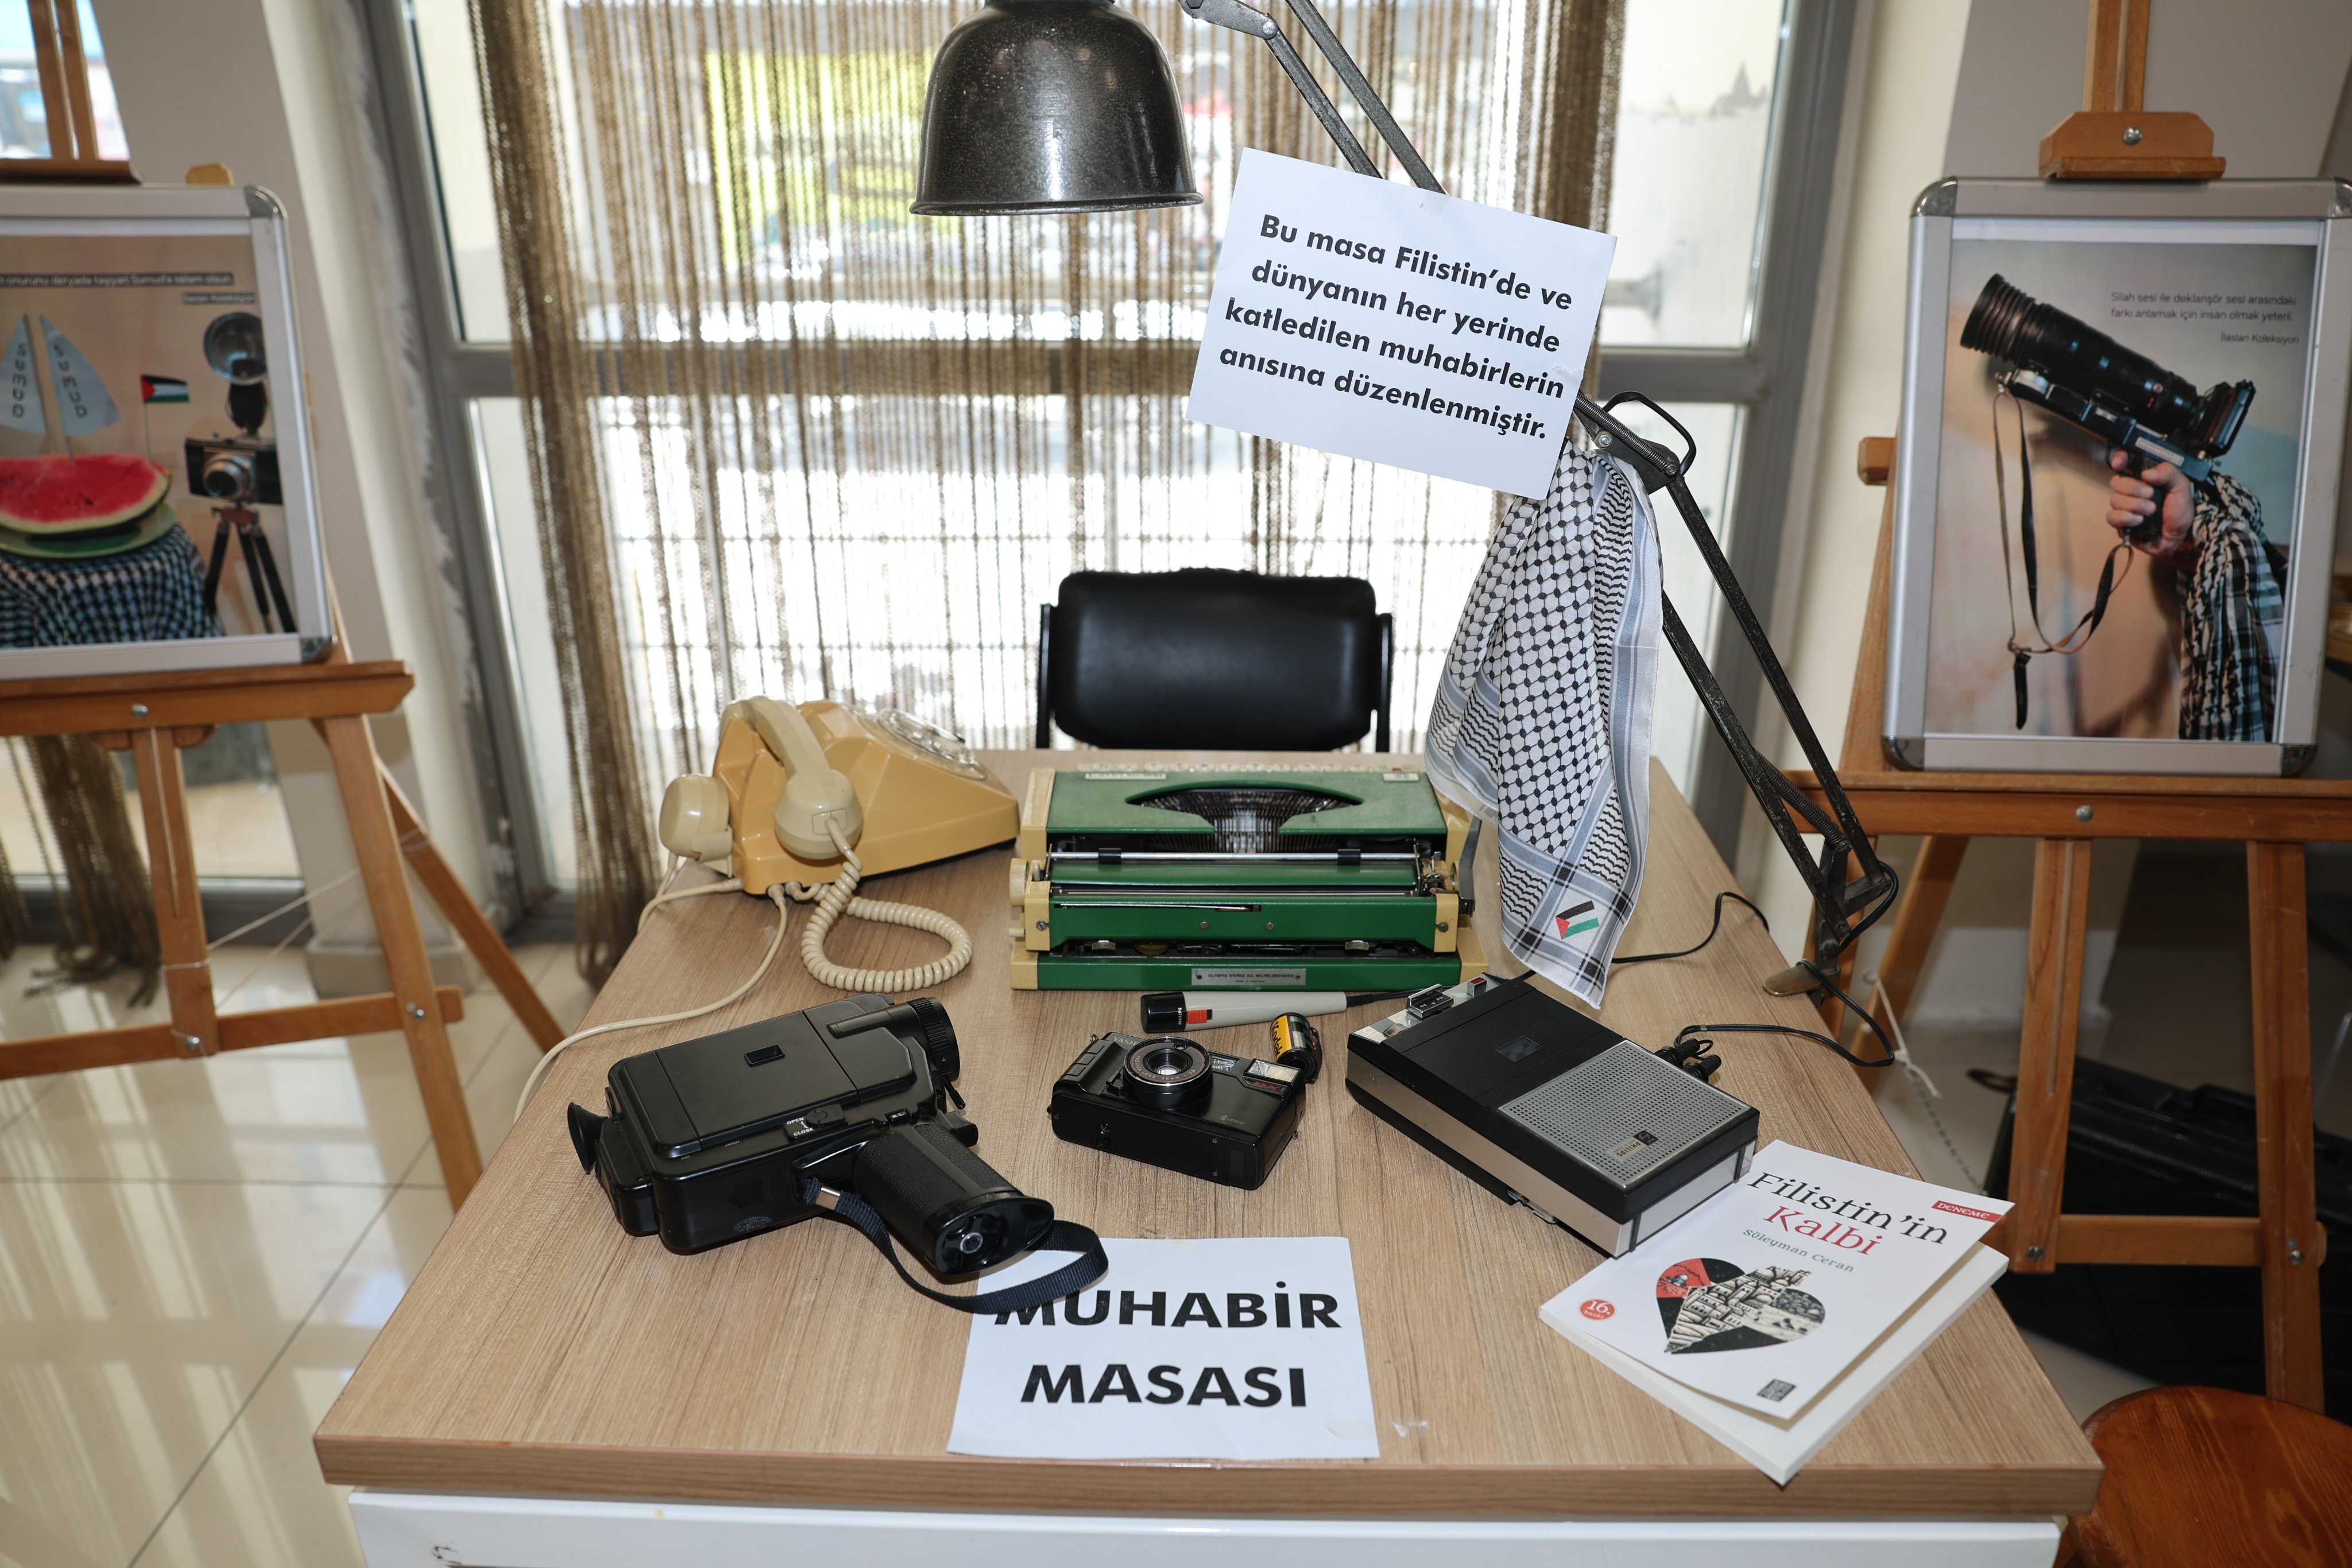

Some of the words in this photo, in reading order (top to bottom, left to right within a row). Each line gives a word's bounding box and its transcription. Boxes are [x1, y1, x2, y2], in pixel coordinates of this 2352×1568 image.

[1260, 214, 1298, 243] Bu
[1306, 231, 1386, 264] masa
[1541, 288, 1572, 310] ve
[1252, 260, 1387, 311] dünyanın
[1396, 291, 1446, 324] her
[1452, 312, 1560, 352] yerinde
[2111, 291, 2135, 303] Silah
[2137, 292, 2157, 303] sesi
[2160, 292, 2172, 303] ile
[2173, 292, 2223, 306] deklanşör
[2226, 293, 2246, 304] sesi
[2248, 294, 2297, 305] arasındaki
[2135, 308, 2177, 319] anlamak
[2180, 309, 2198, 322] için
[2200, 310, 2227, 320] insan
[2229, 311, 2260, 320] olmak
[1225, 297, 1370, 352] katledilen
[1379, 340, 1564, 399] muhabirlerin
[1220, 349, 1325, 386] anısına
[1334, 370, 1546, 439] düzenlenmiştir.
[1113, 1036, 1140, 1046] YASH
[1134, 1055, 1143, 1073] YASHICA
[1142, 1070, 1156, 1079] LENS
[786, 1117, 804, 1125] OPEN
[793, 1127, 814, 1137] CLOSE
[1616, 1141, 1642, 1157] PHILIPS
[1937, 1202, 1990, 1219] DENEME
[1763, 1205, 1883, 1255] Kalbi
[1587, 1300, 1611, 1314] 16.
[1020, 1364, 1306, 1407] MASASI
